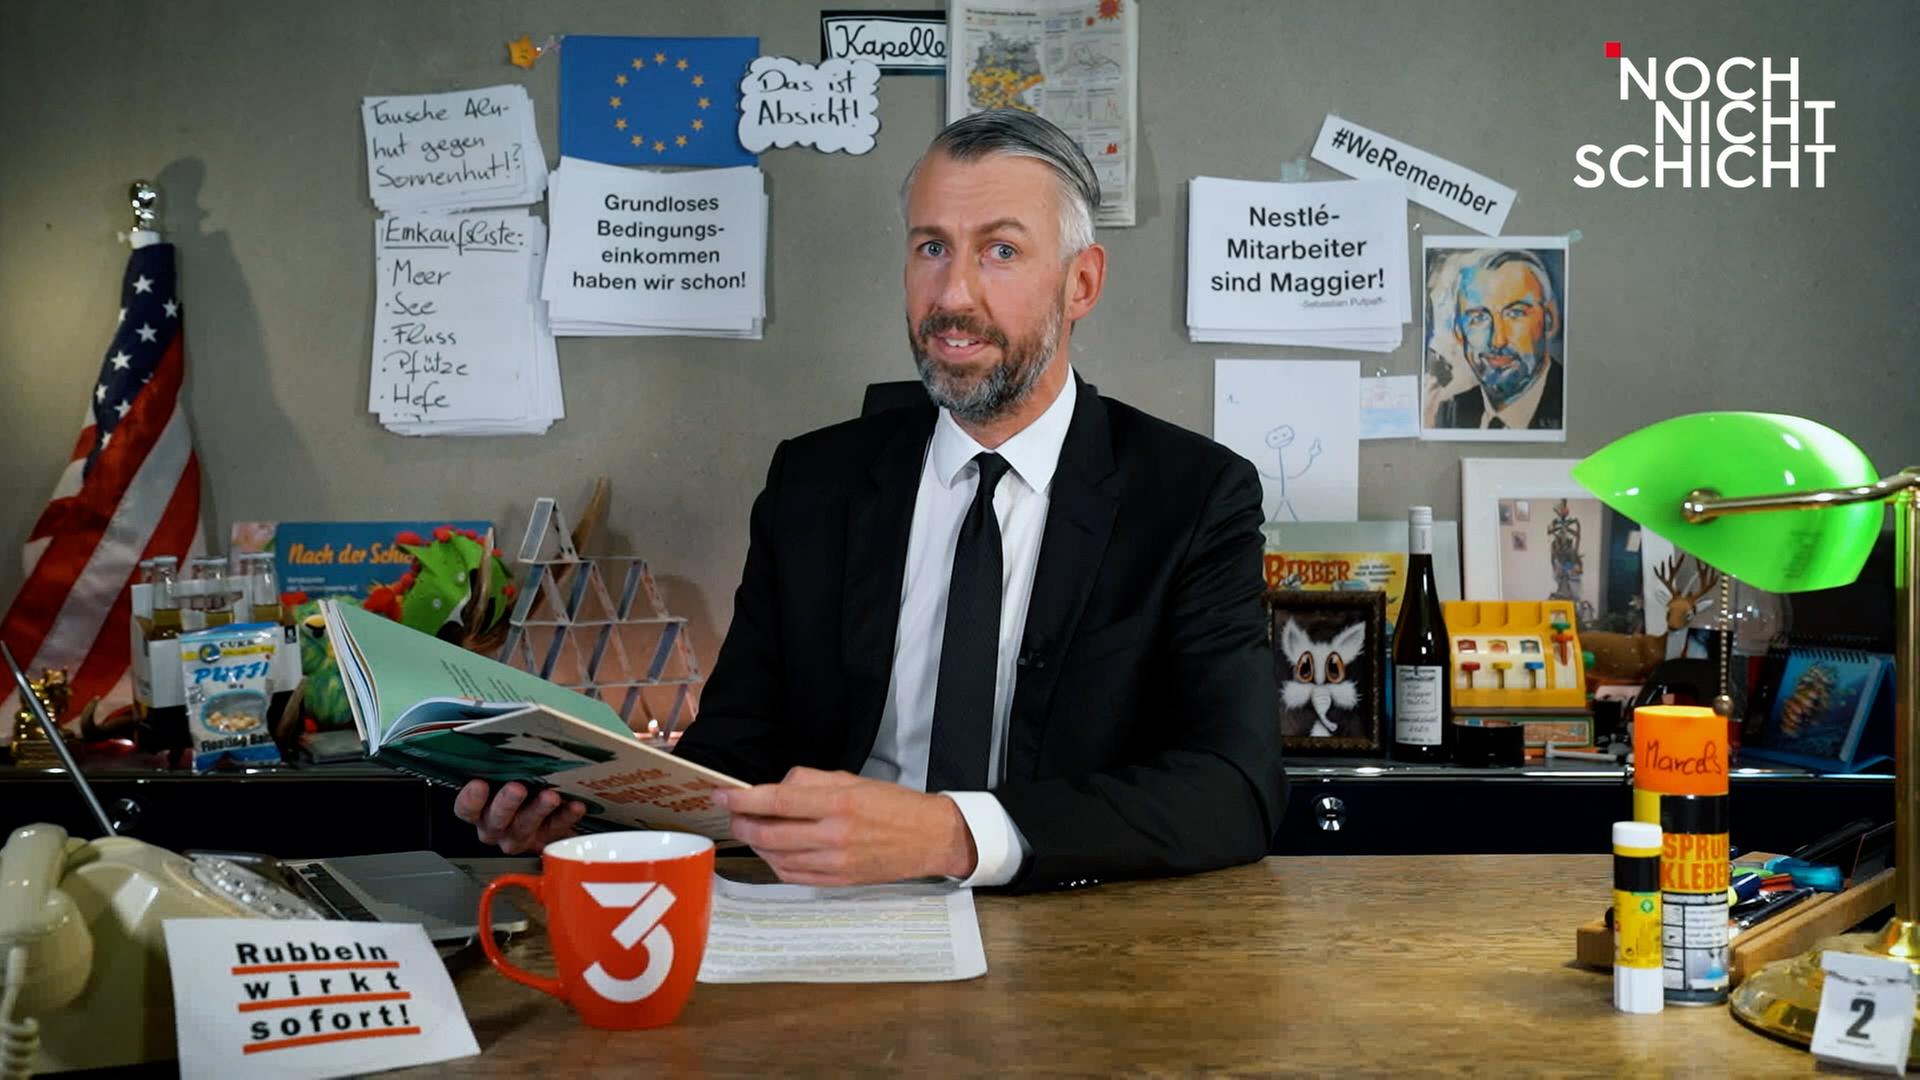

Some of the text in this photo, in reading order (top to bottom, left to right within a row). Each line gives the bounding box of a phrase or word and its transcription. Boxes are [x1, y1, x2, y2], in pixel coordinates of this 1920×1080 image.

[835, 25, 947, 61] Kapelle
[757, 69, 856, 93] Das ist
[371, 97, 510, 126] Tausche Alu-
[758, 97, 859, 128] Absicht!
[373, 132, 486, 163] hut gegen
[1331, 126, 1498, 218] #WeRemember
[604, 194, 719, 213] Grundloses
[1249, 204, 1341, 228] Nestlé-
[385, 216, 524, 256] Einkaufsliste:
[597, 219, 725, 242] Bedingungs-
[601, 247, 720, 265] einkommen
[1227, 238, 1367, 261] Mitarbeiter
[392, 259, 451, 287] Meer
[572, 271, 746, 291] haben wir schon!
[1211, 268, 1385, 297] sind Maggier!
[392, 291, 437, 316] See
[391, 322, 457, 346] Fluss
[384, 350, 469, 382] Pfütze
[393, 381, 449, 413] Hefe
[287, 543, 334, 565] Nach
[338, 543, 369, 565] der
[235, 941, 388, 965] Rubbeln
[580, 882, 677, 1003] 3
[244, 971, 401, 1000] wirkt
[251, 1004, 412, 1041] sofort!
[1845, 998, 1876, 1040] 2
